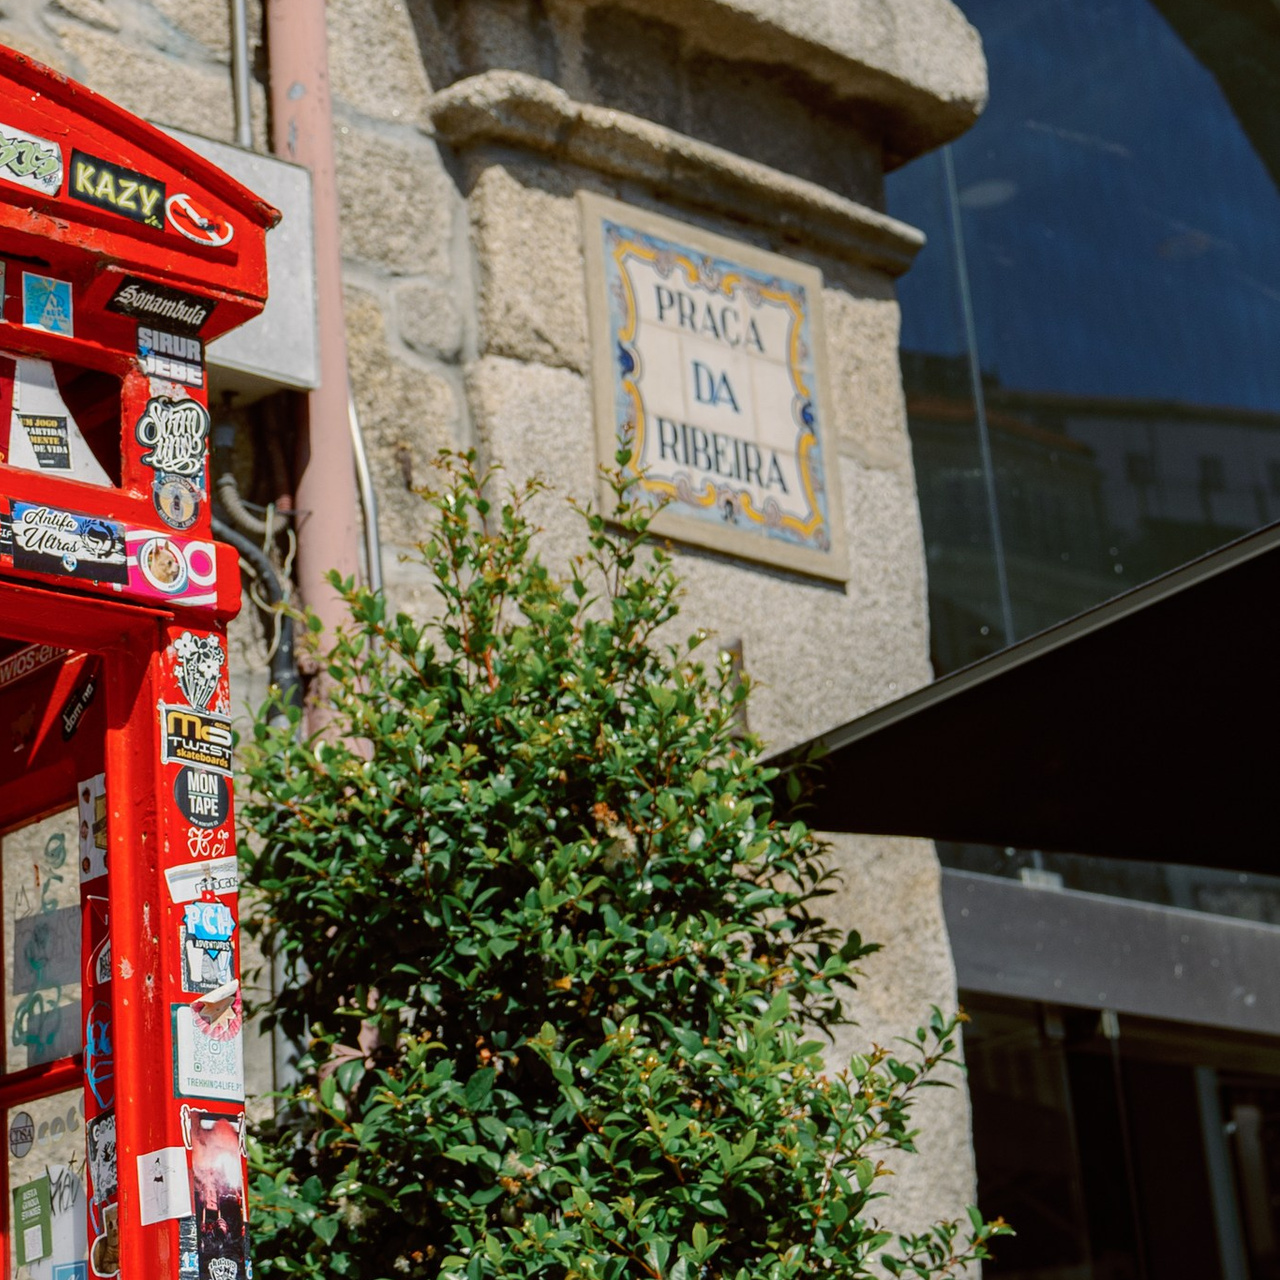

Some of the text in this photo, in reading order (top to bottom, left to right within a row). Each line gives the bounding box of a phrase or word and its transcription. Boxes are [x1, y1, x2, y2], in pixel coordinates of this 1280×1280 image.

[75, 162, 160, 216] KAZY
[119, 281, 207, 327] Sonambula
[653, 283, 766, 354] PRAÇA
[691, 361, 741, 415] DA
[33, 444, 69, 454] DE VIDA
[657, 417, 790, 495] RIBEIRA
[23, 507, 76, 530] Antifa
[23, 529, 81, 556] Ultras
[168, 736, 233, 759] TWIST
[176, 747, 229, 768] skateboards
[188, 795, 220, 817] TAPE
[186, 904, 234, 936] PCH
